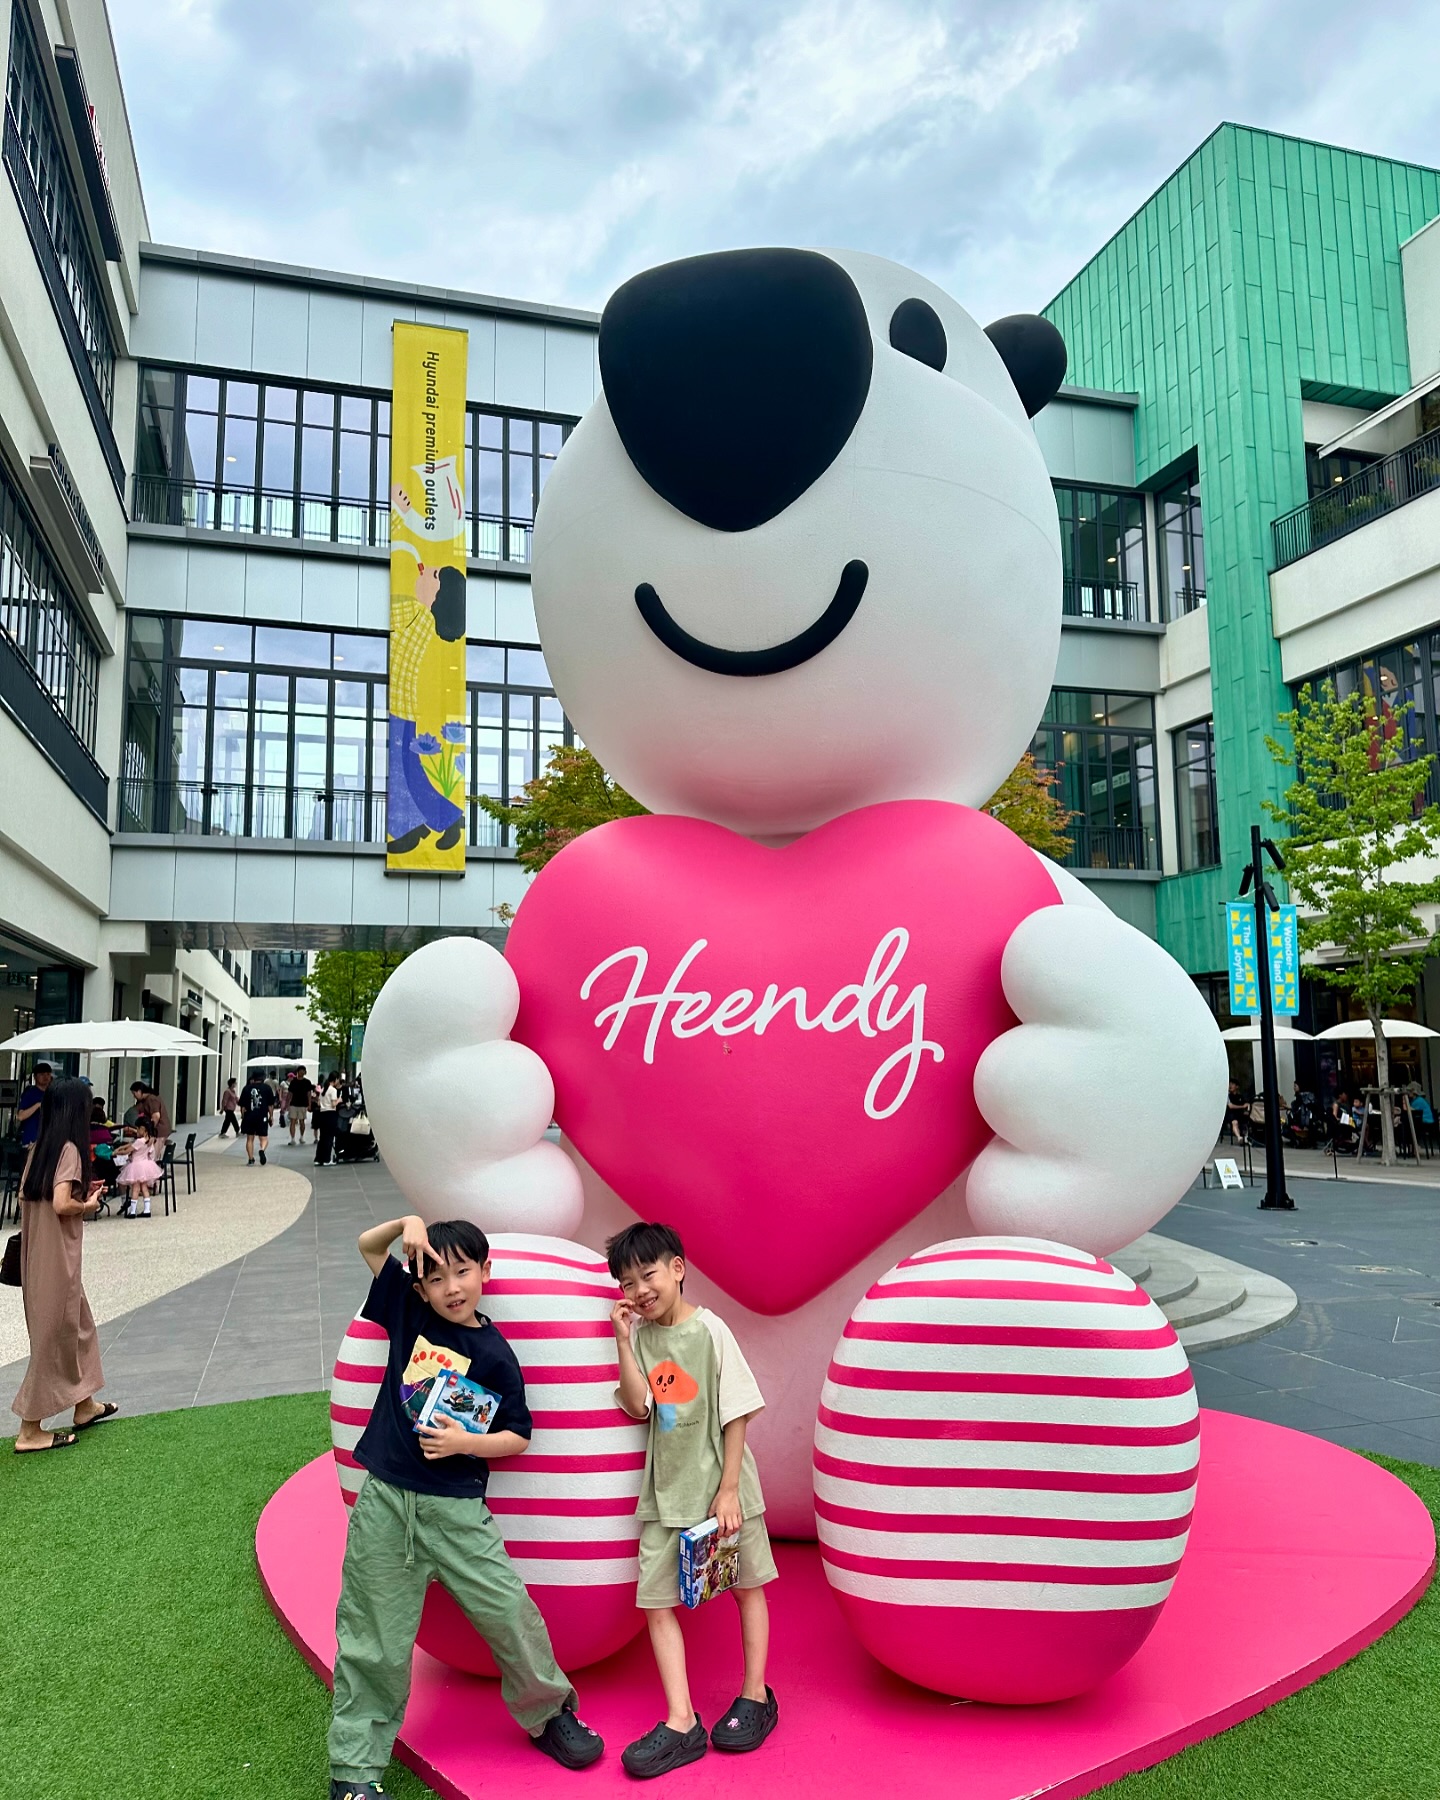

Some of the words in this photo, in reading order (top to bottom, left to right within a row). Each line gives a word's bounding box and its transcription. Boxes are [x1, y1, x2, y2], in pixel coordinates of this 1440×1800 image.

[422, 351, 440, 409] Hyundai
[422, 412, 437, 475] premium
[424, 478, 437, 531] outlets
[1243, 925, 1252, 945] The
[1284, 926, 1294, 971] Wonder-
[1233, 949, 1245, 982] Joyful
[1273, 959, 1285, 983] land
[580, 927, 945, 1120] Heendy
[413, 1350, 427, 1364] GO
